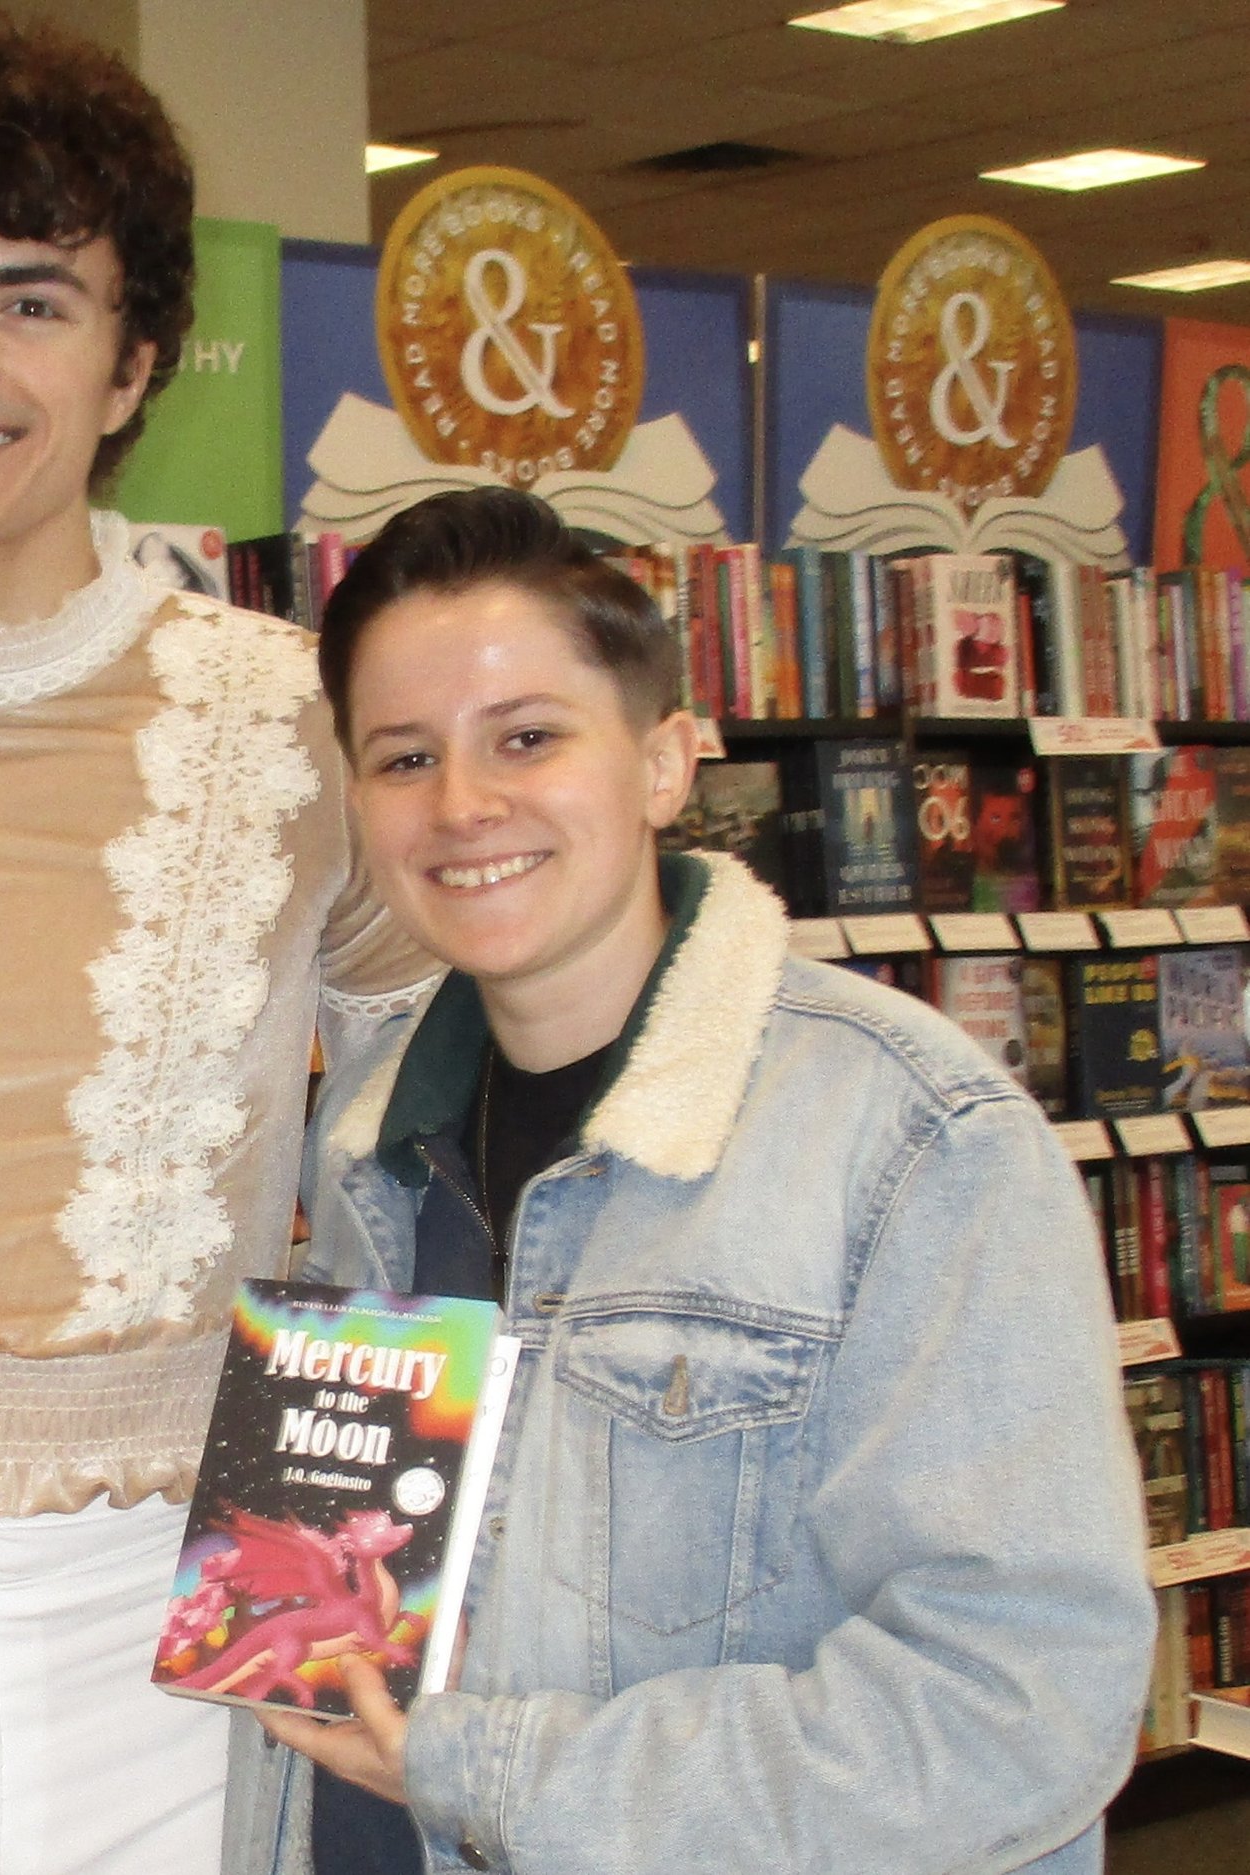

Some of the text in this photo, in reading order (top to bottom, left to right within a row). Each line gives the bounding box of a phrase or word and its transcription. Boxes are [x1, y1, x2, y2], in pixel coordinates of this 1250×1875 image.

[402, 232, 446, 326] MORE
[568, 249, 618, 344] READ
[460, 249, 575, 419] &
[405, 343, 457, 437] READ
[574, 358, 620, 452] MORE
[263, 1328, 448, 1400] Mercury
[316, 1388, 370, 1414] to the
[274, 1407, 393, 1466] Moon
[311, 1470, 372, 1493] Gagliastro
